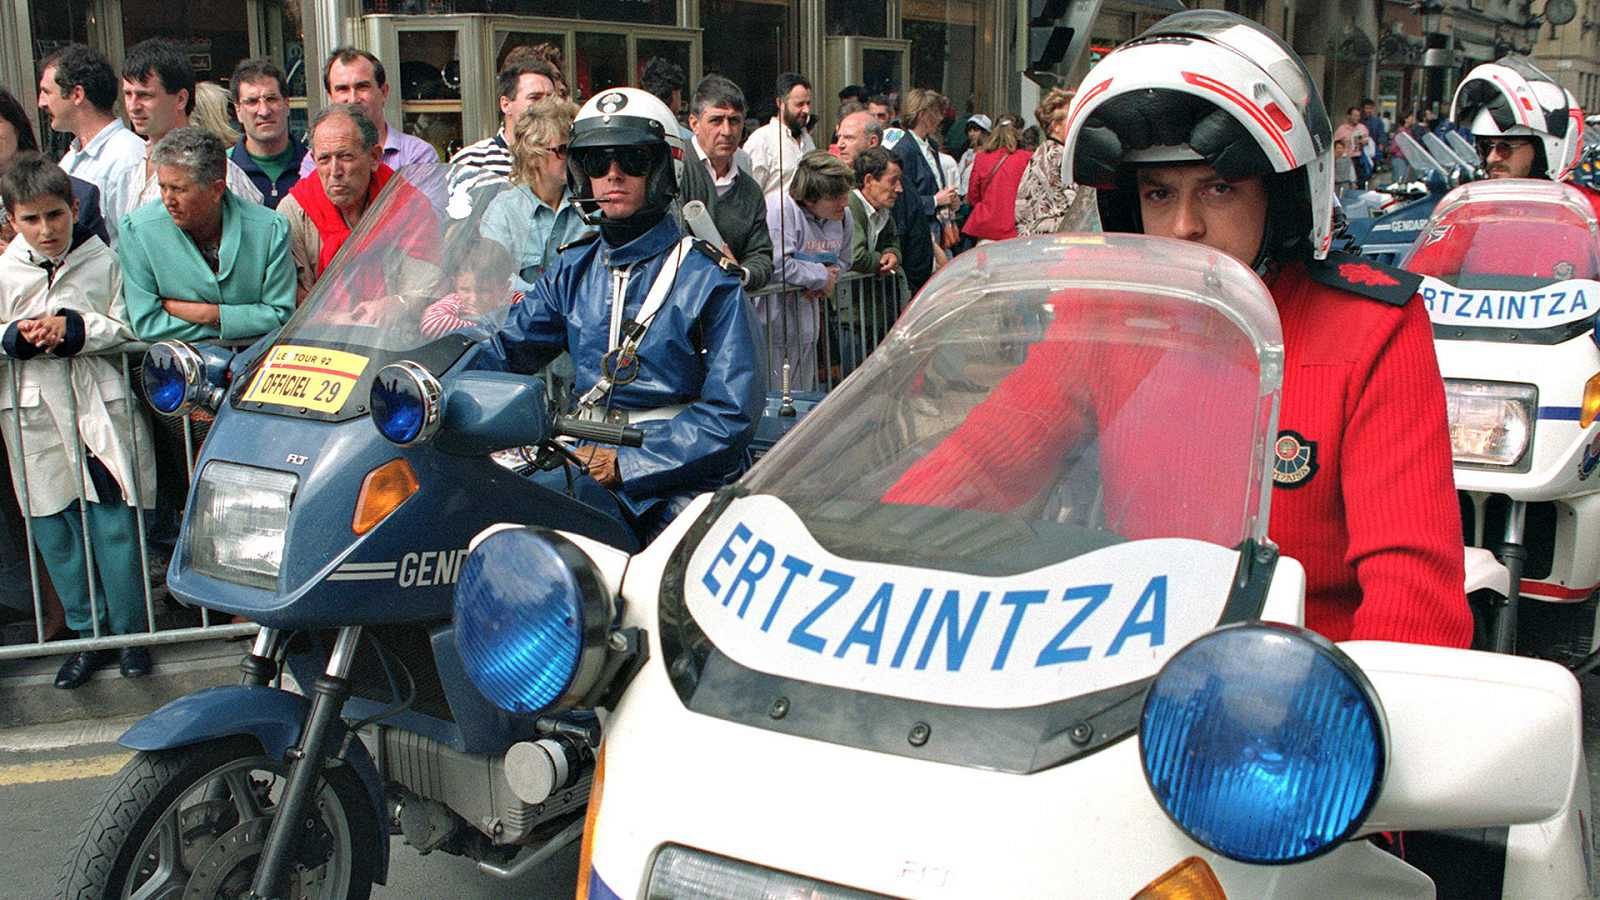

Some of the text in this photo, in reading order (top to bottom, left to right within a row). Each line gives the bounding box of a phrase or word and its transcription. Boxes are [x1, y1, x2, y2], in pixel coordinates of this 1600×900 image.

[1391, 219, 1430, 232] GENDAR
[1419, 287, 1588, 320] RTZAINTZA
[275, 351, 332, 366] LE TOUR 92
[260, 373, 342, 404] OFFICIEL 29
[701, 521, 1168, 672] ERTZAINTZA
